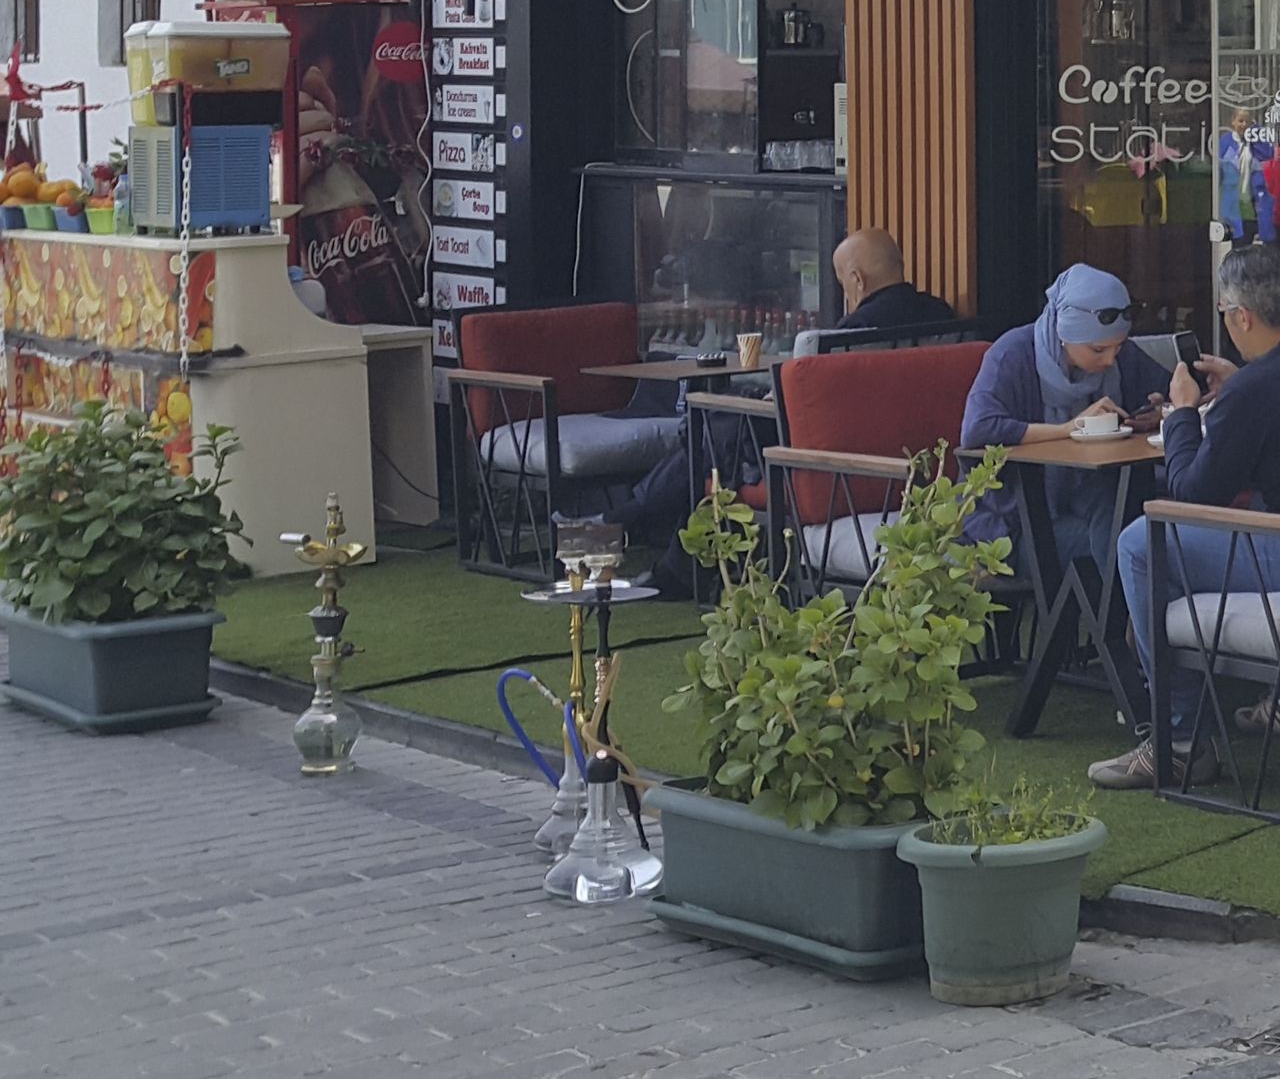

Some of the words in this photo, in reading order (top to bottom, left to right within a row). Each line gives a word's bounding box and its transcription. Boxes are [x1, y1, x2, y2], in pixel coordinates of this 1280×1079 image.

[1058, 65, 1210, 105] Coffee
[1050, 121, 1231, 164] stati
[1244, 128, 1275, 143] ESEN
[439, 140, 466, 162] Pizza
[472, 201, 490, 215] Soup
[308, 214, 389, 278] Coca-Cola
[457, 284, 490, 305] Waffle
